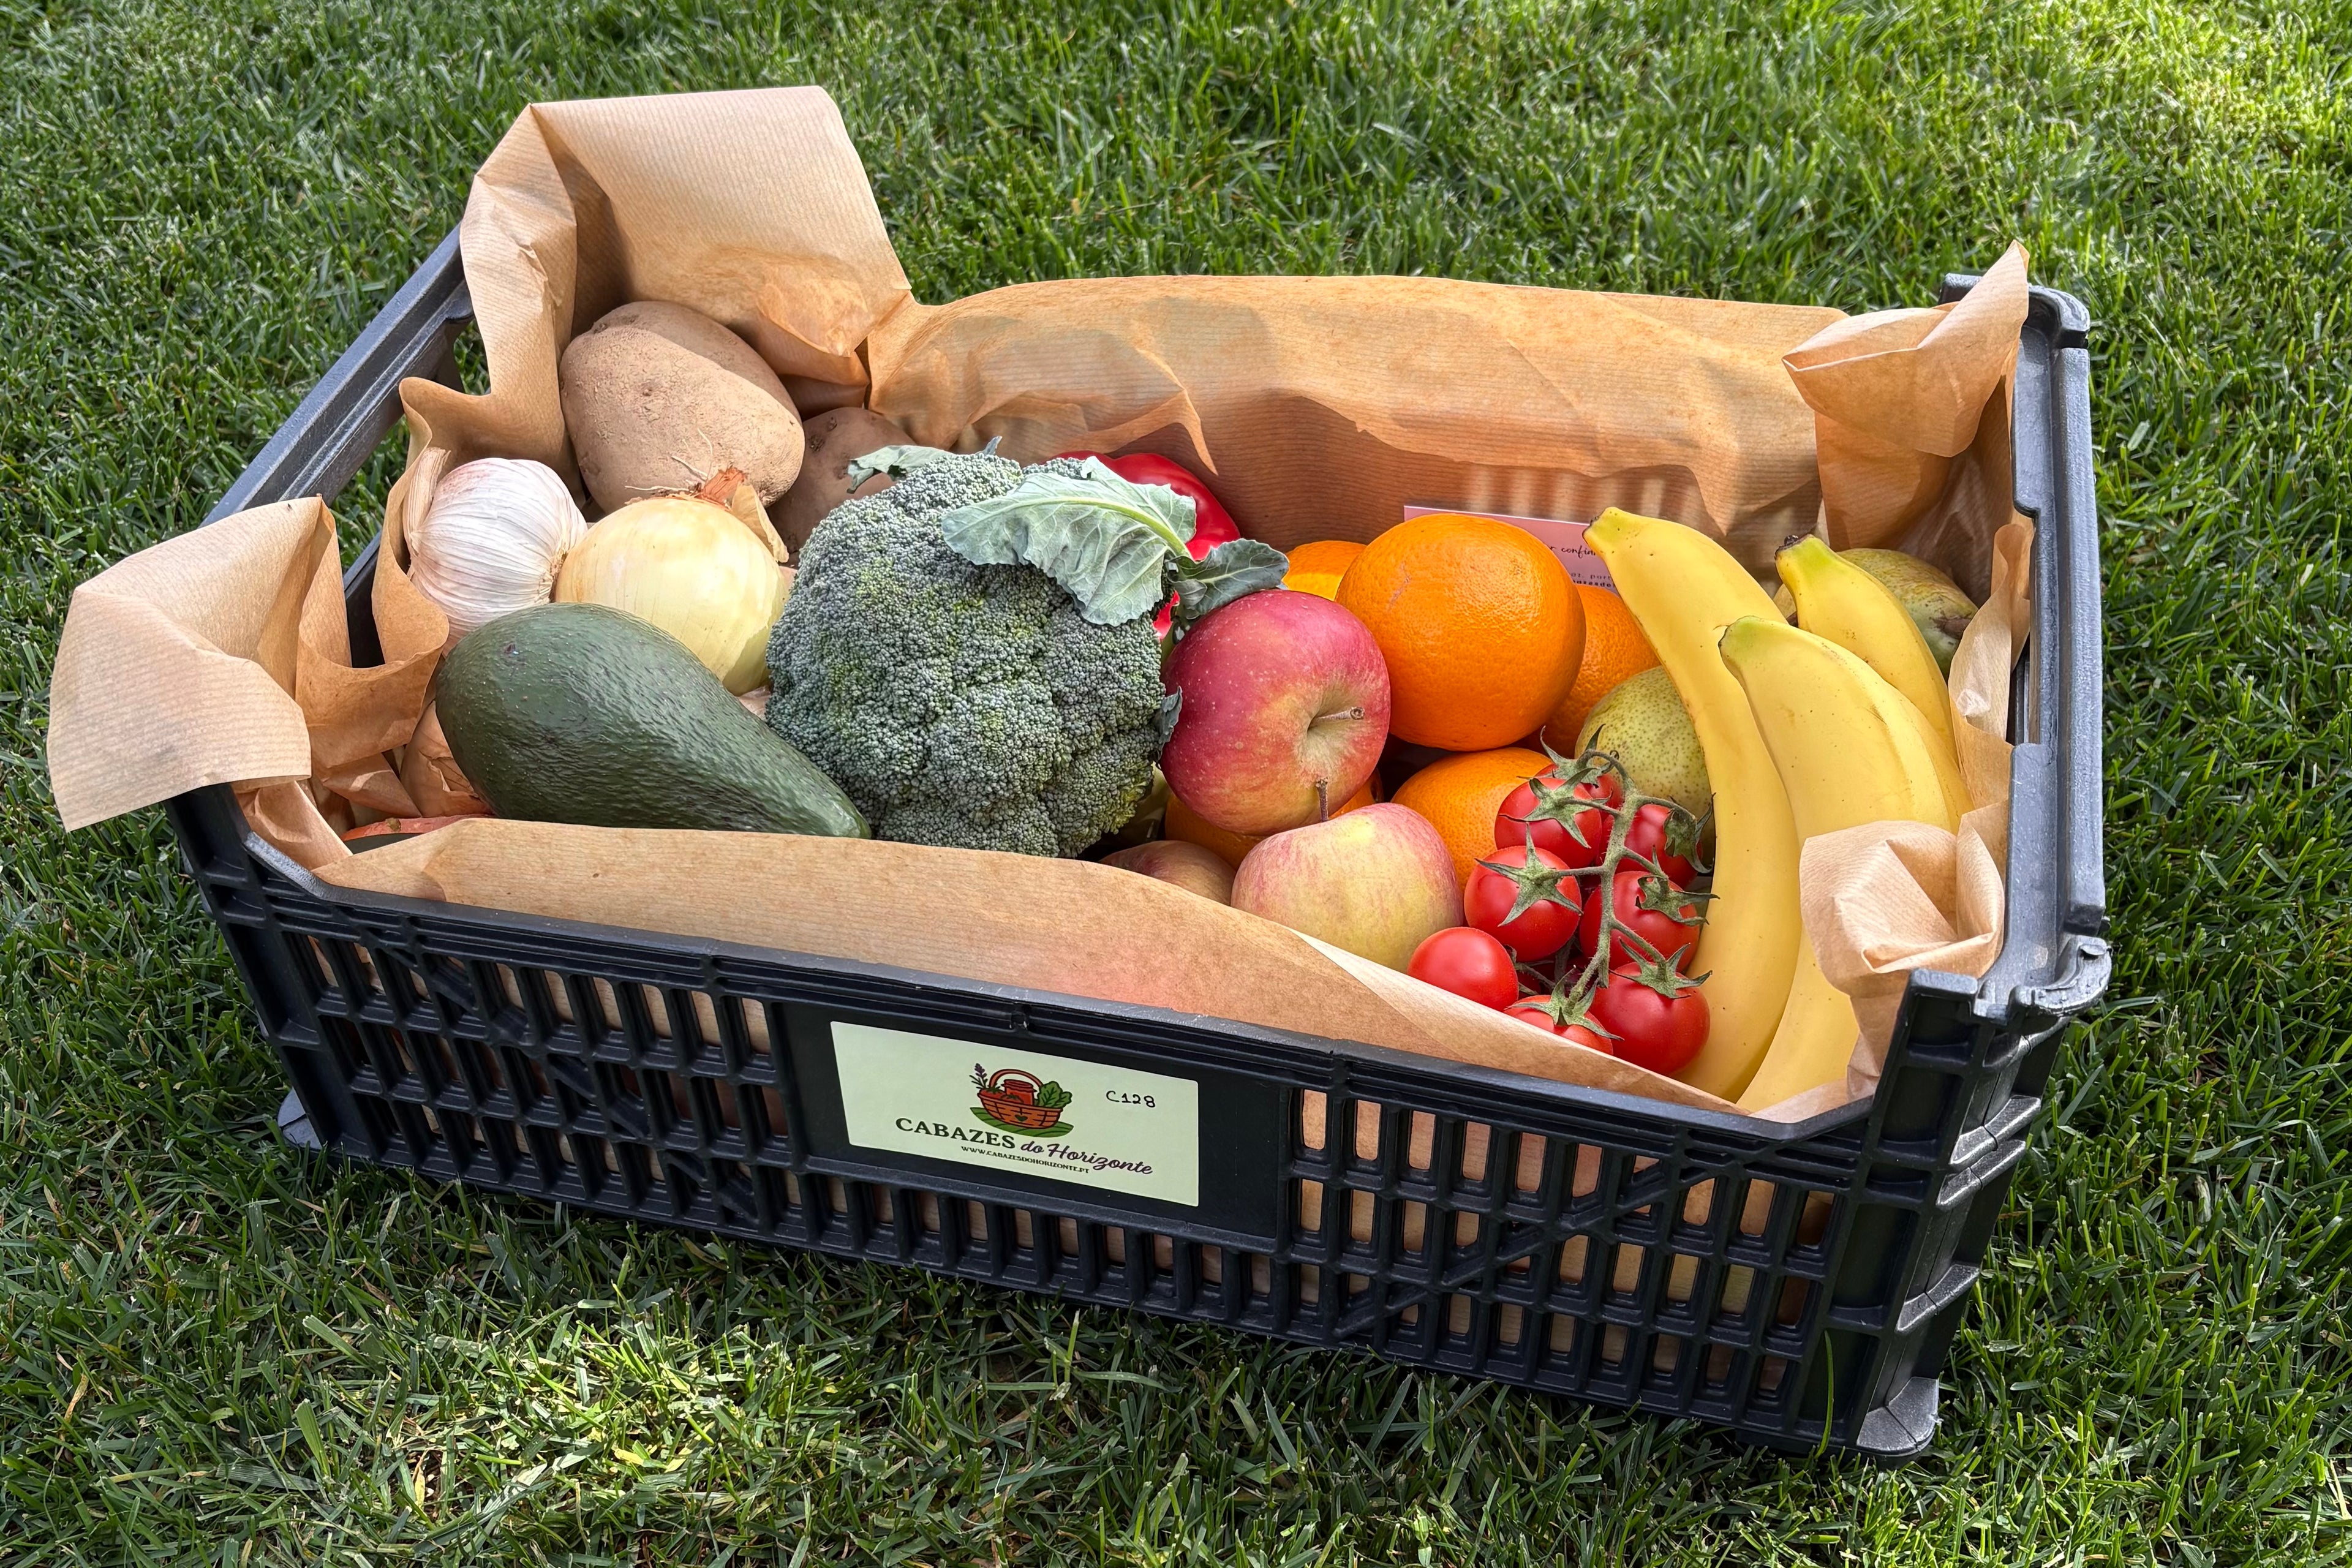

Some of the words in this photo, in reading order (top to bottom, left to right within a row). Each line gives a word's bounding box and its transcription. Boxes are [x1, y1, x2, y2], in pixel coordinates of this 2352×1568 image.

[1106, 1090, 1156, 1108] C128
[895, 1118, 1016, 1149] CABAZES
[1020, 1140, 1044, 1153] do
[1047, 1143, 1153, 1175] Horizonte
